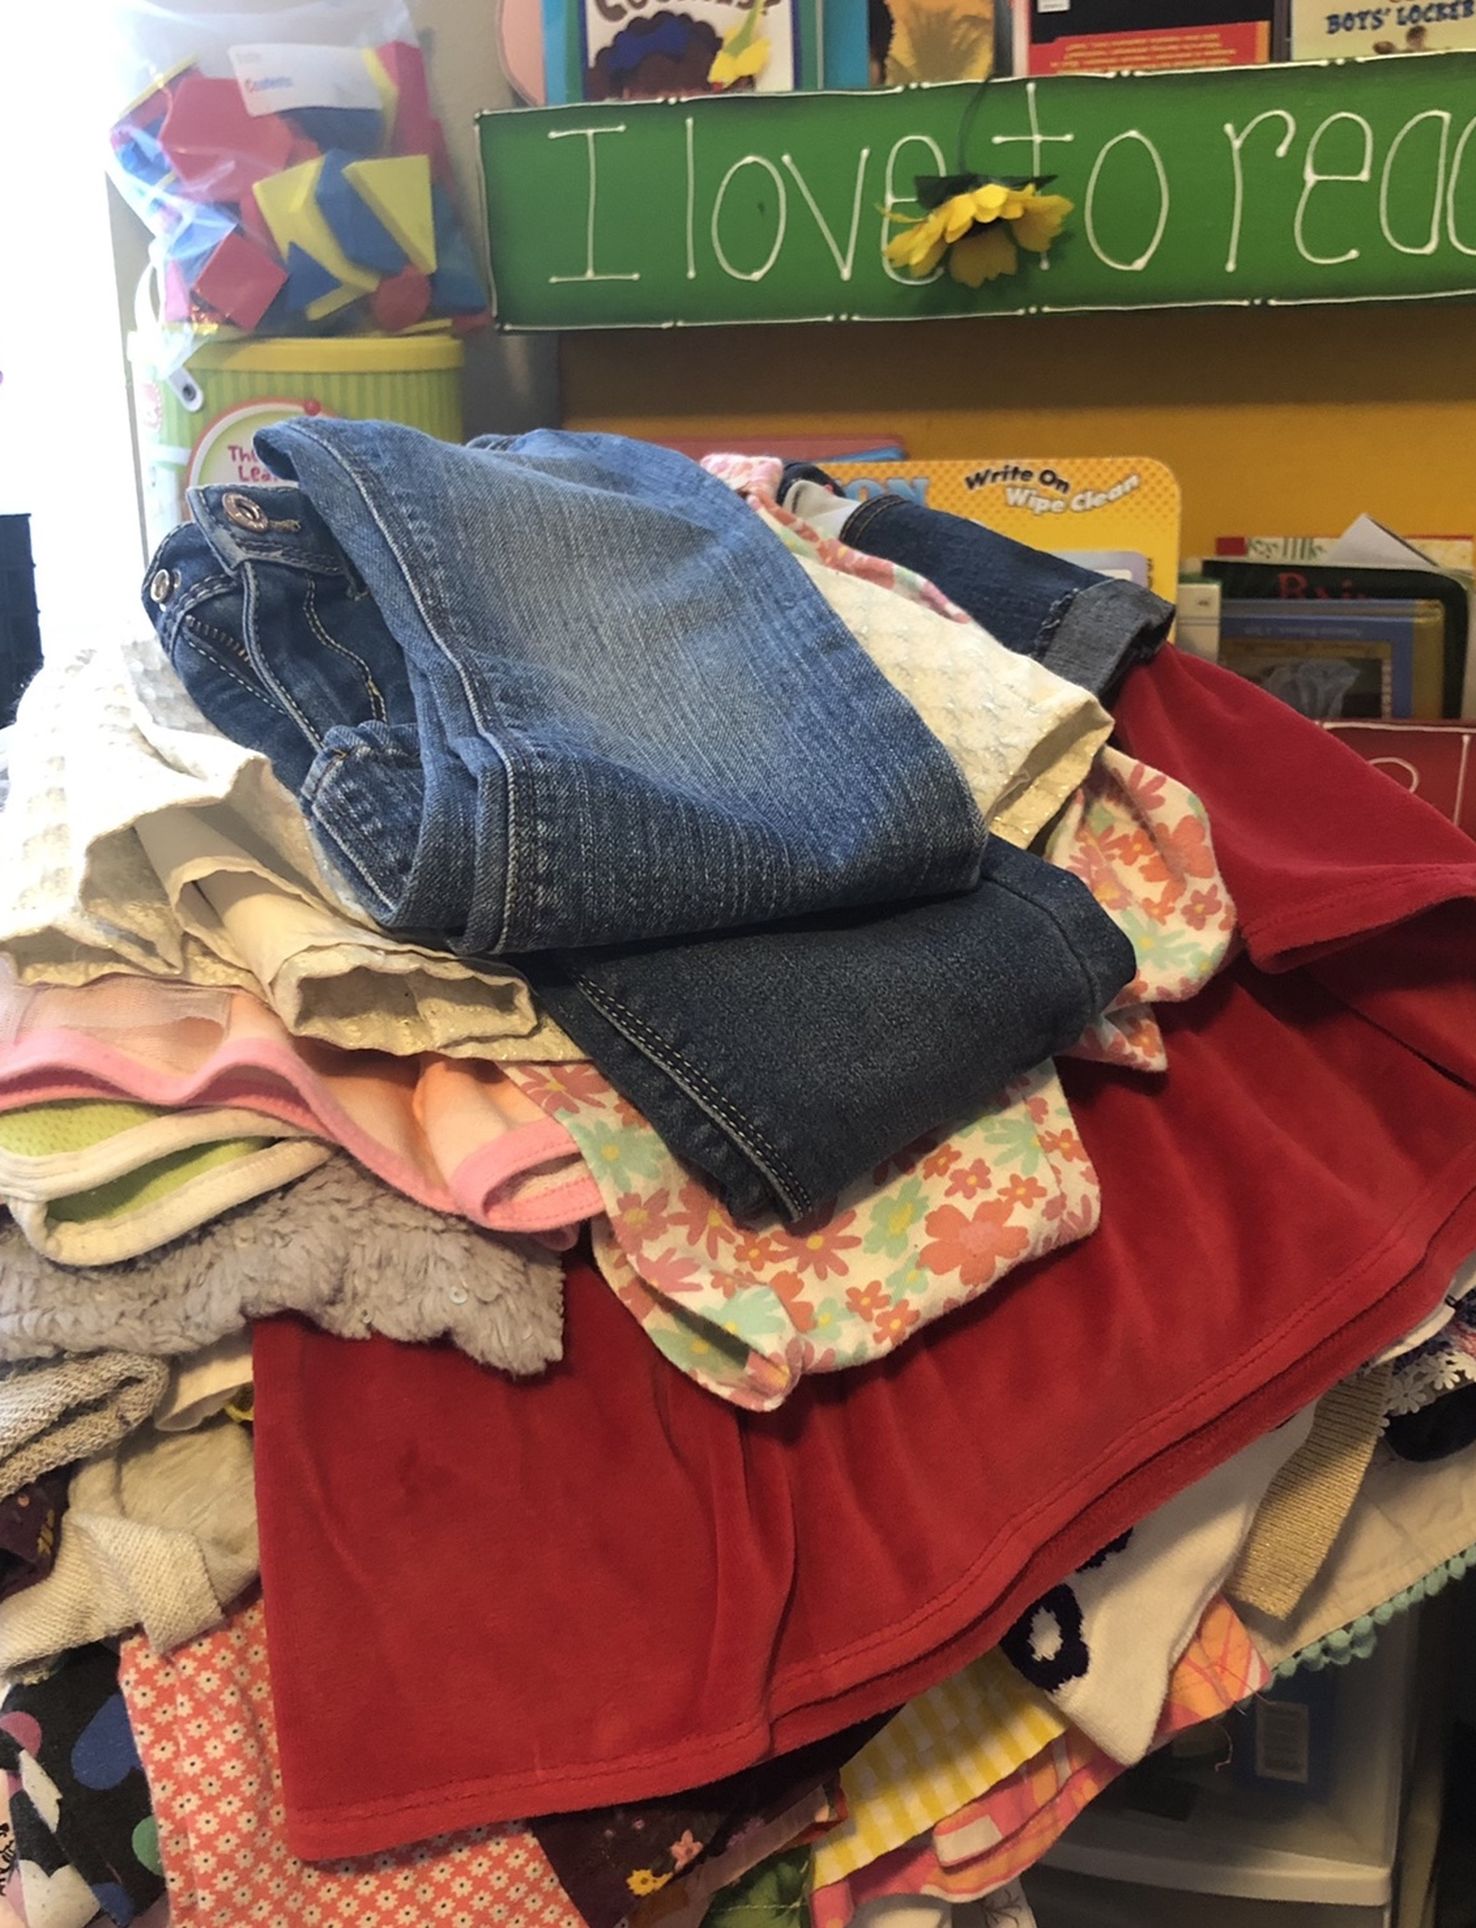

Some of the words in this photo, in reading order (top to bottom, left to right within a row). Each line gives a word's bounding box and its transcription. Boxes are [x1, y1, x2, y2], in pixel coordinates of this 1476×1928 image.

[1325, 7, 1391, 35] BOYS'
[548, 123, 640, 284] I
[684, 116, 947, 286] love
[992, 81, 1170, 272] to
[238, 465, 278, 483] Lea
[965, 464, 1033, 490] Write
[1039, 468, 1071, 495] On
[1005, 486, 1067, 516] Wipe
[1070, 474, 1141, 513] Clean
